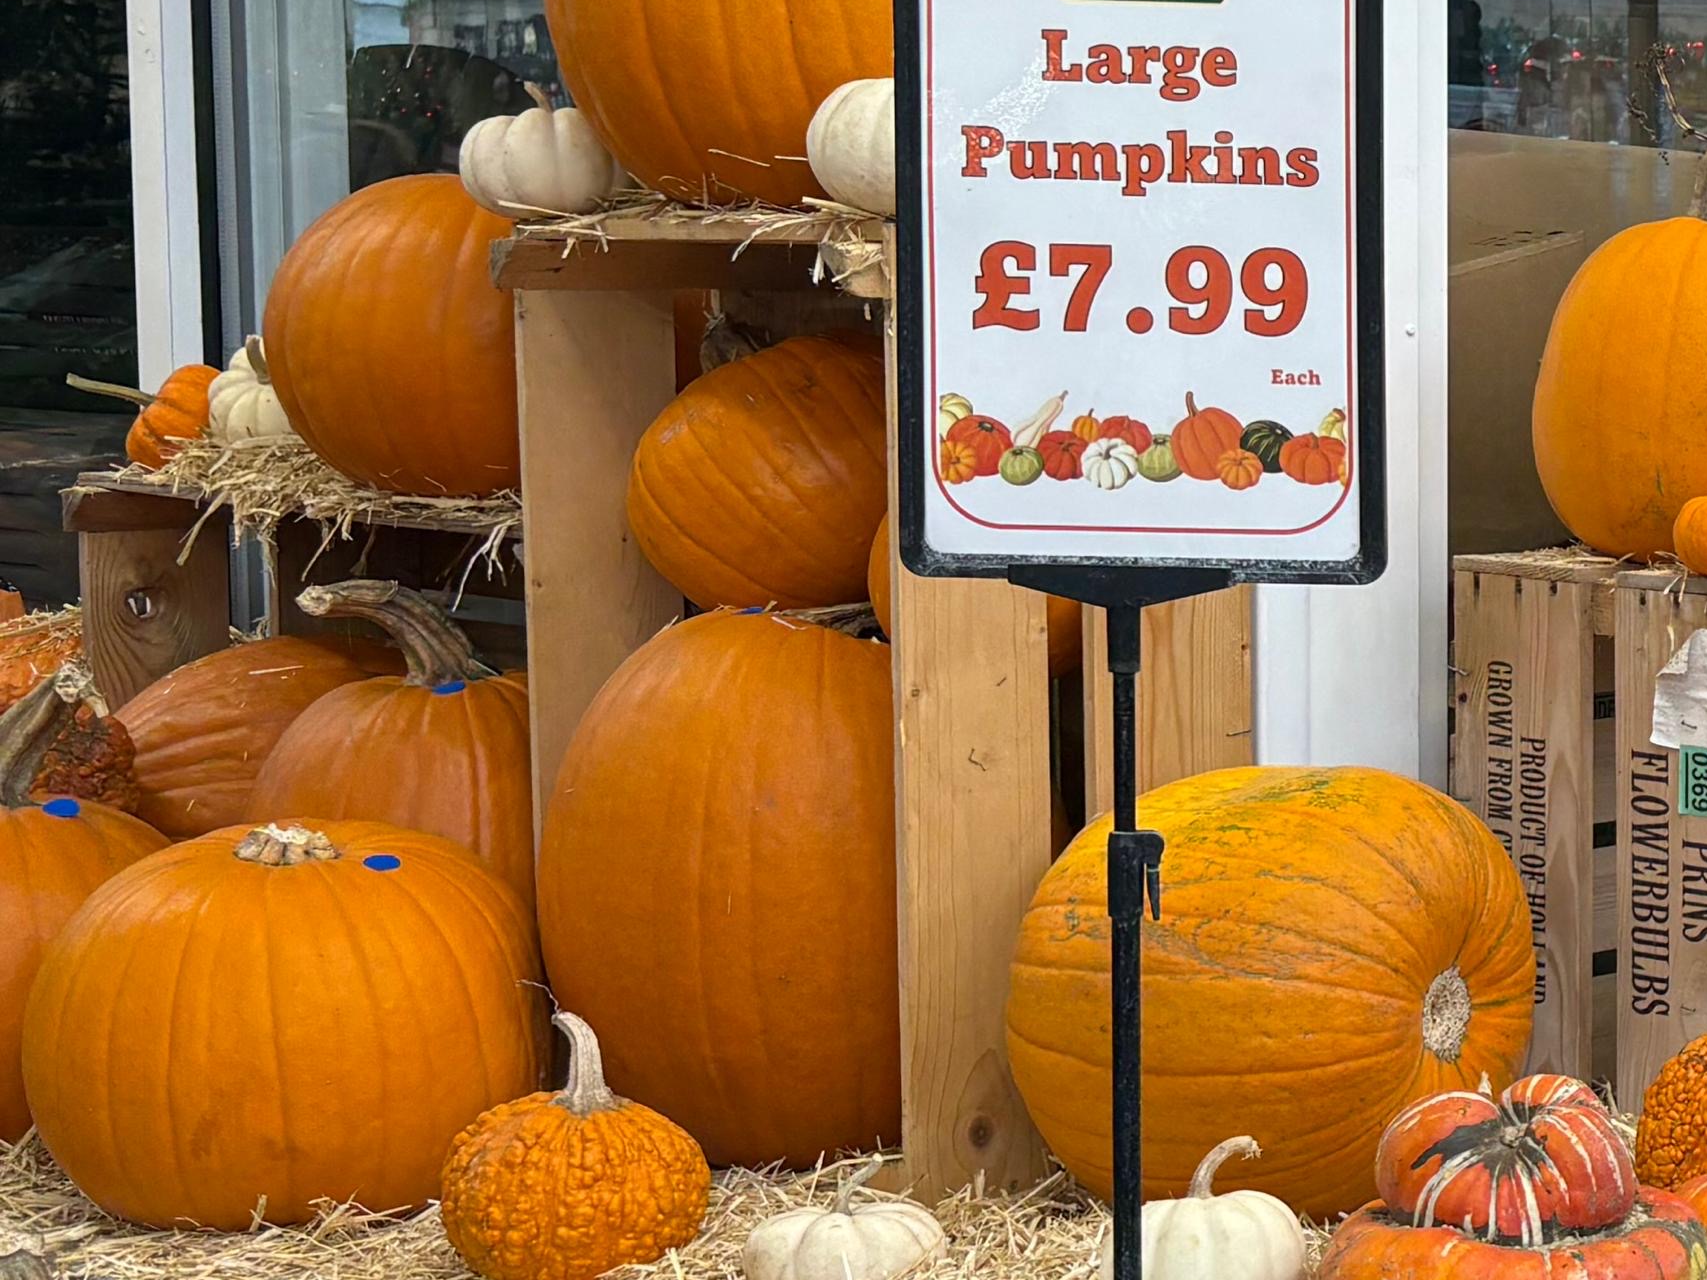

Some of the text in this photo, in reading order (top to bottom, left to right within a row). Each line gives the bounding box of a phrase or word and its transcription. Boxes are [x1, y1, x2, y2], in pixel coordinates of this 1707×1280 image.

[1042, 30, 1237, 101] Large
[962, 126, 1319, 196] Pumpkins
[973, 241, 1307, 336] £7.99
[1270, 368, 1321, 386] Each
[1487, 660, 1513, 748] GROWN
[1488, 756, 1513, 820] FROM
[1520, 735, 1547, 846] PRODUCT
[1520, 853, 1546, 886] OF
[1630, 748, 1670, 1016] FLOWERBULBS
